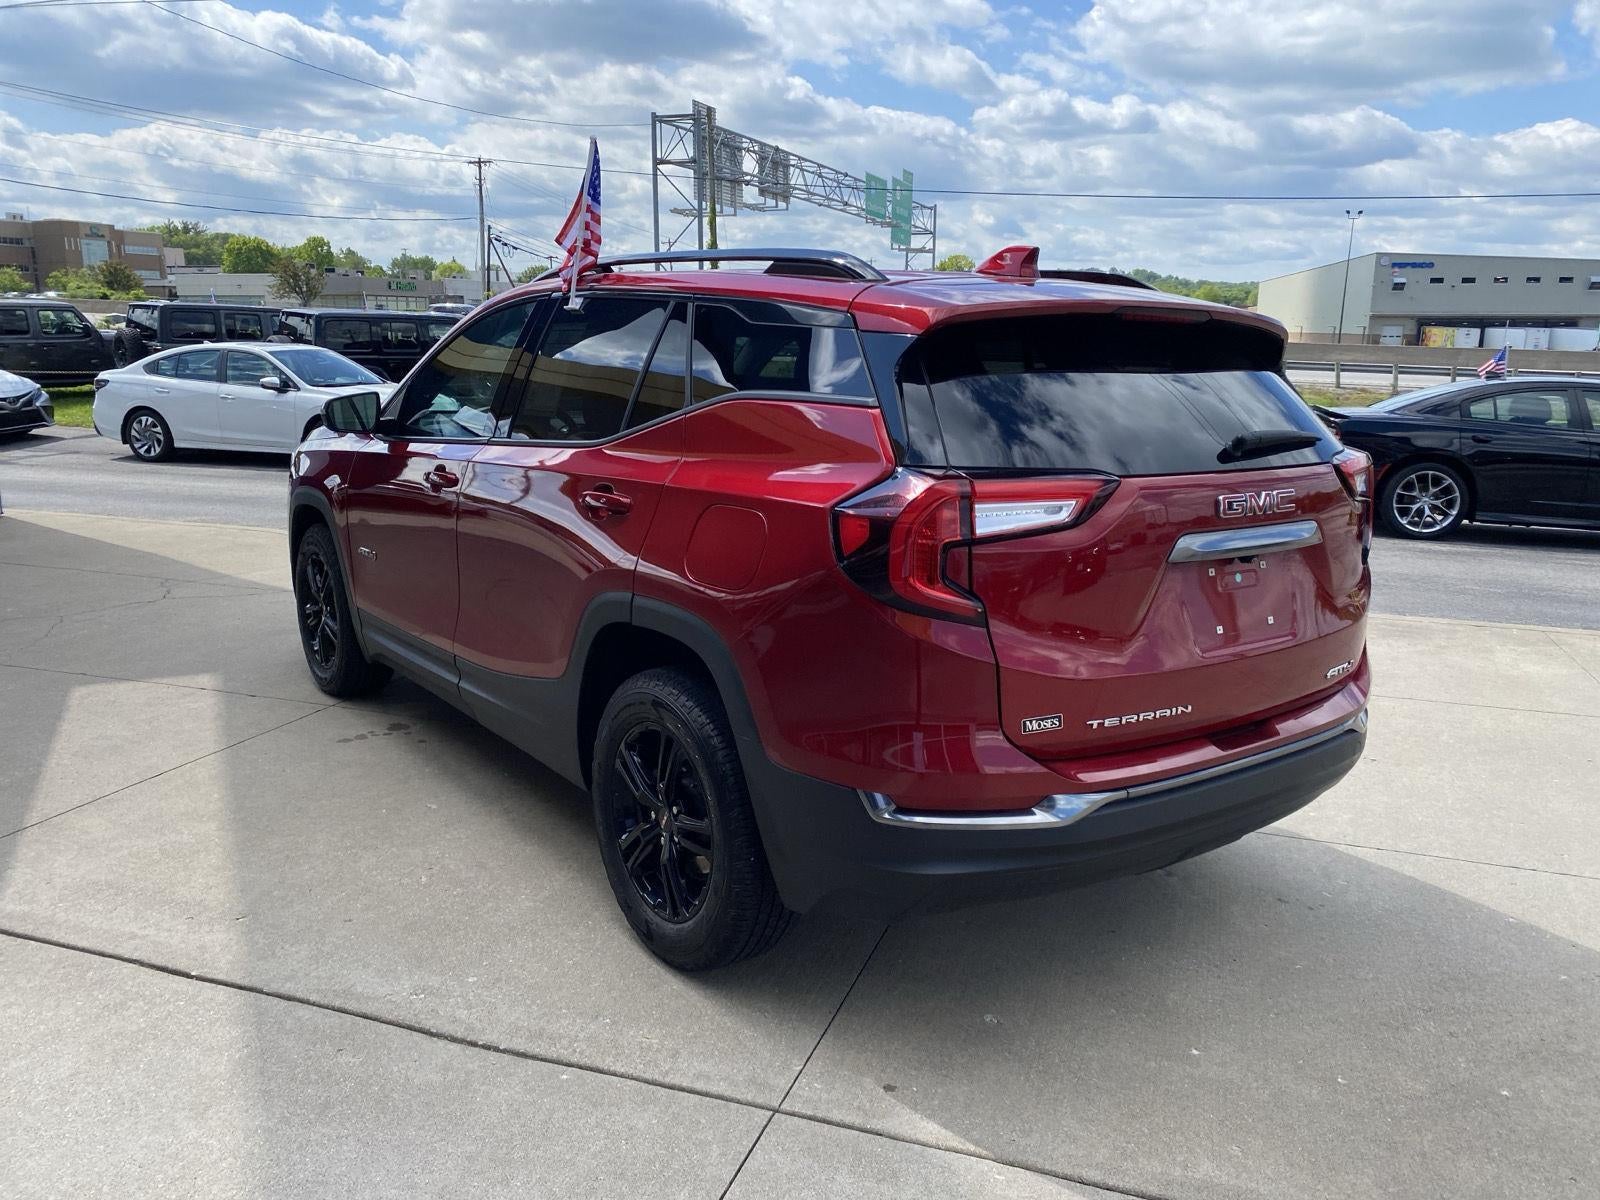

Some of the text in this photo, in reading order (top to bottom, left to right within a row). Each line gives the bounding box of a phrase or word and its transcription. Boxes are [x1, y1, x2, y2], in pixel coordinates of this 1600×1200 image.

[1217, 489, 1296, 519] GMC
[1025, 718, 1060, 731] MOSES
[1086, 704, 1192, 729] TERRAIN
